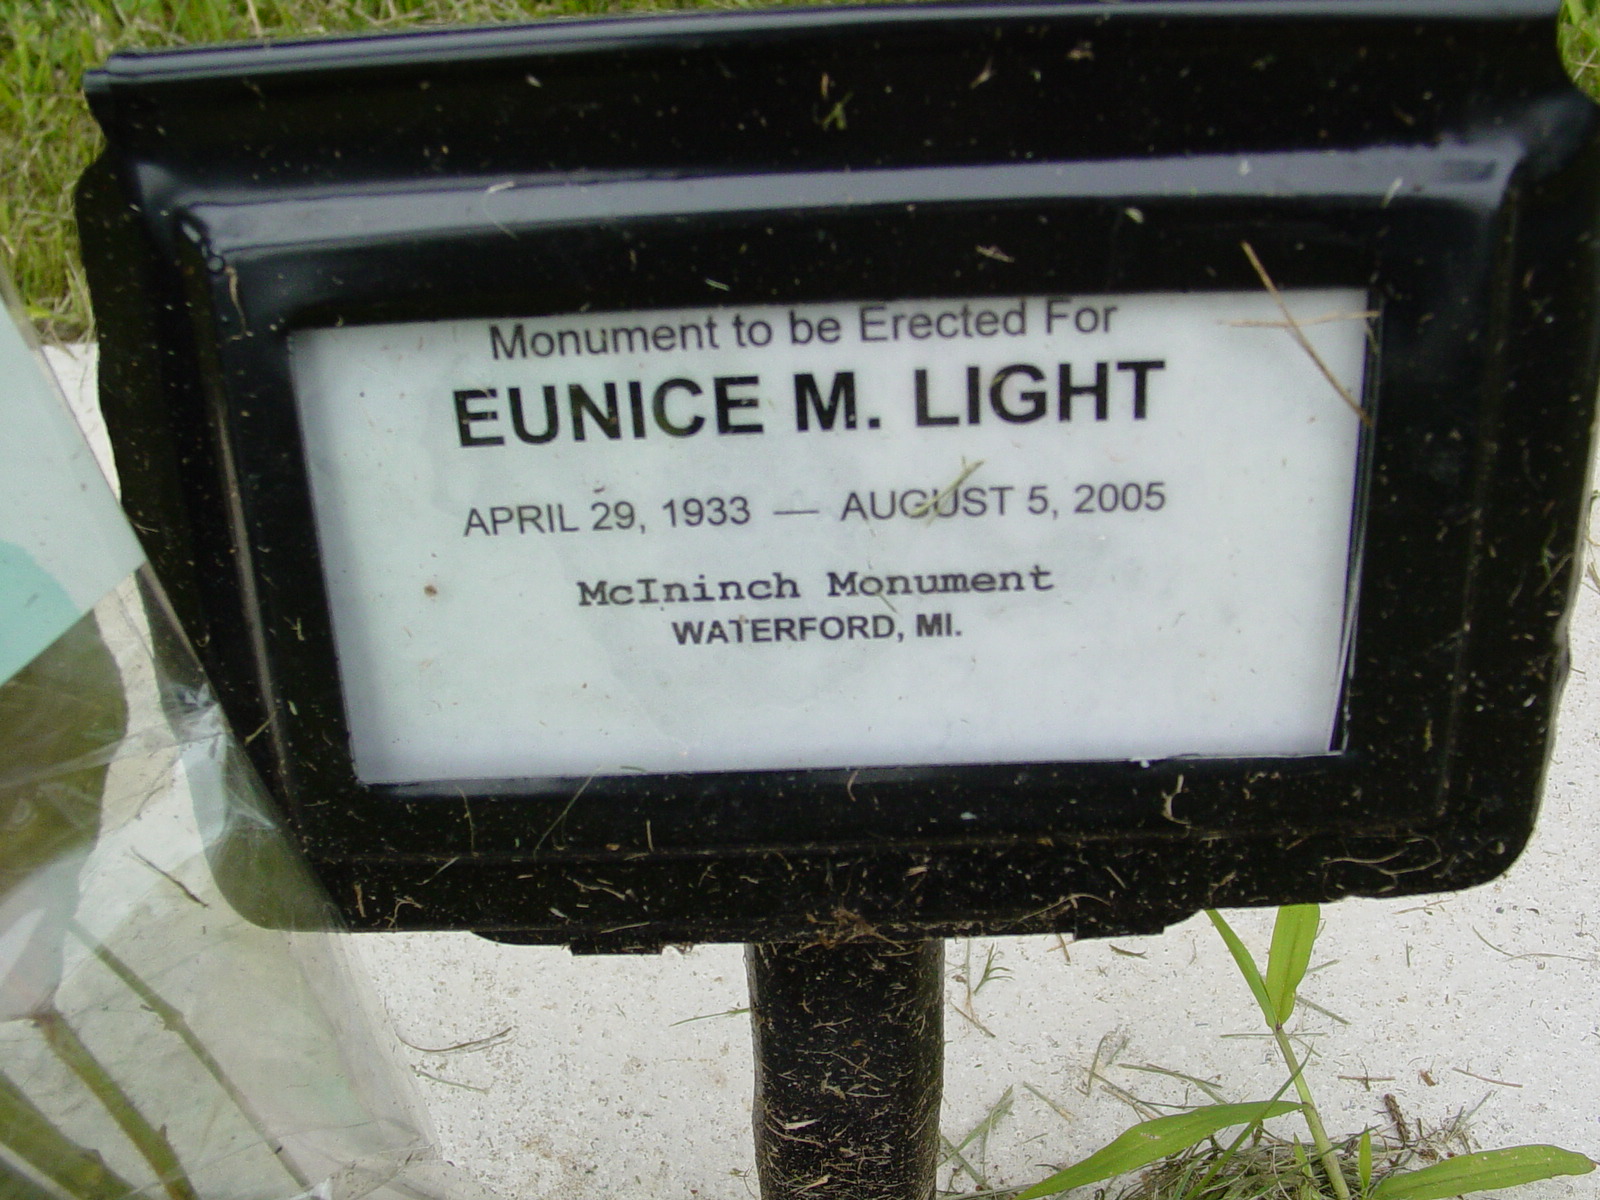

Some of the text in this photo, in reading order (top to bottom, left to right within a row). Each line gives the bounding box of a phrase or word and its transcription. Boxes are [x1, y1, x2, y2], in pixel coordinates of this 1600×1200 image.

[490, 299, 1118, 360] Monument to be Erected For
[453, 360, 1166, 447] EUNICE M. LIGHT
[464, 501, 579, 536] APRIL
[591, 501, 646, 534] 29,
[662, 495, 751, 528] 1933
[840, 486, 1016, 523] AUGUST
[1028, 485, 1060, 519] 5,
[1074, 481, 1166, 513] 2005
[577, 565, 1054, 607] McIninch Monument
[671, 612, 963, 646] WATERFORD, MI.
